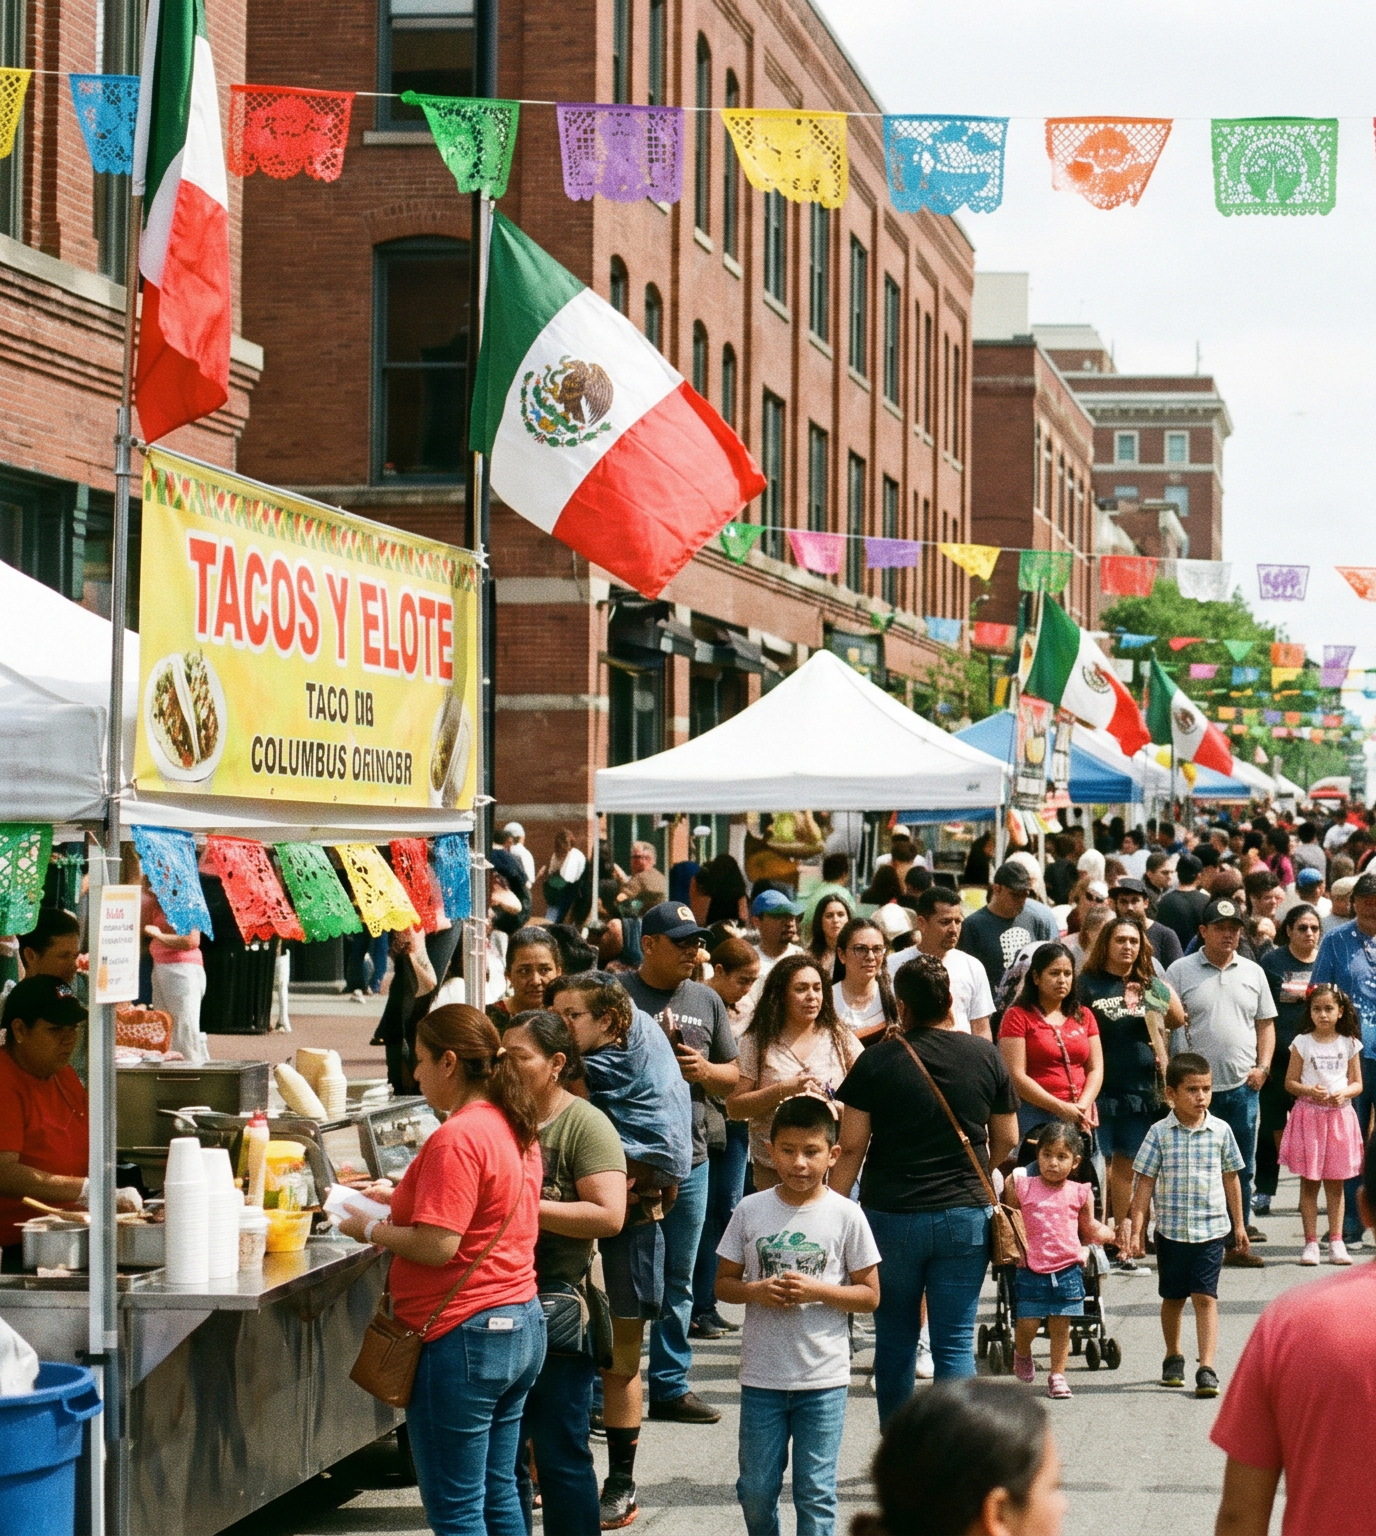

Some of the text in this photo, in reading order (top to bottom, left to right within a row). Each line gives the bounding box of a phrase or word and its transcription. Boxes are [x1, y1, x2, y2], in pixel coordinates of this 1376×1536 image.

[188, 536, 453, 681] TACOS Y ELOTE
[306, 682, 349, 723] TACO
[251, 735, 347, 780] COLUMBUS
